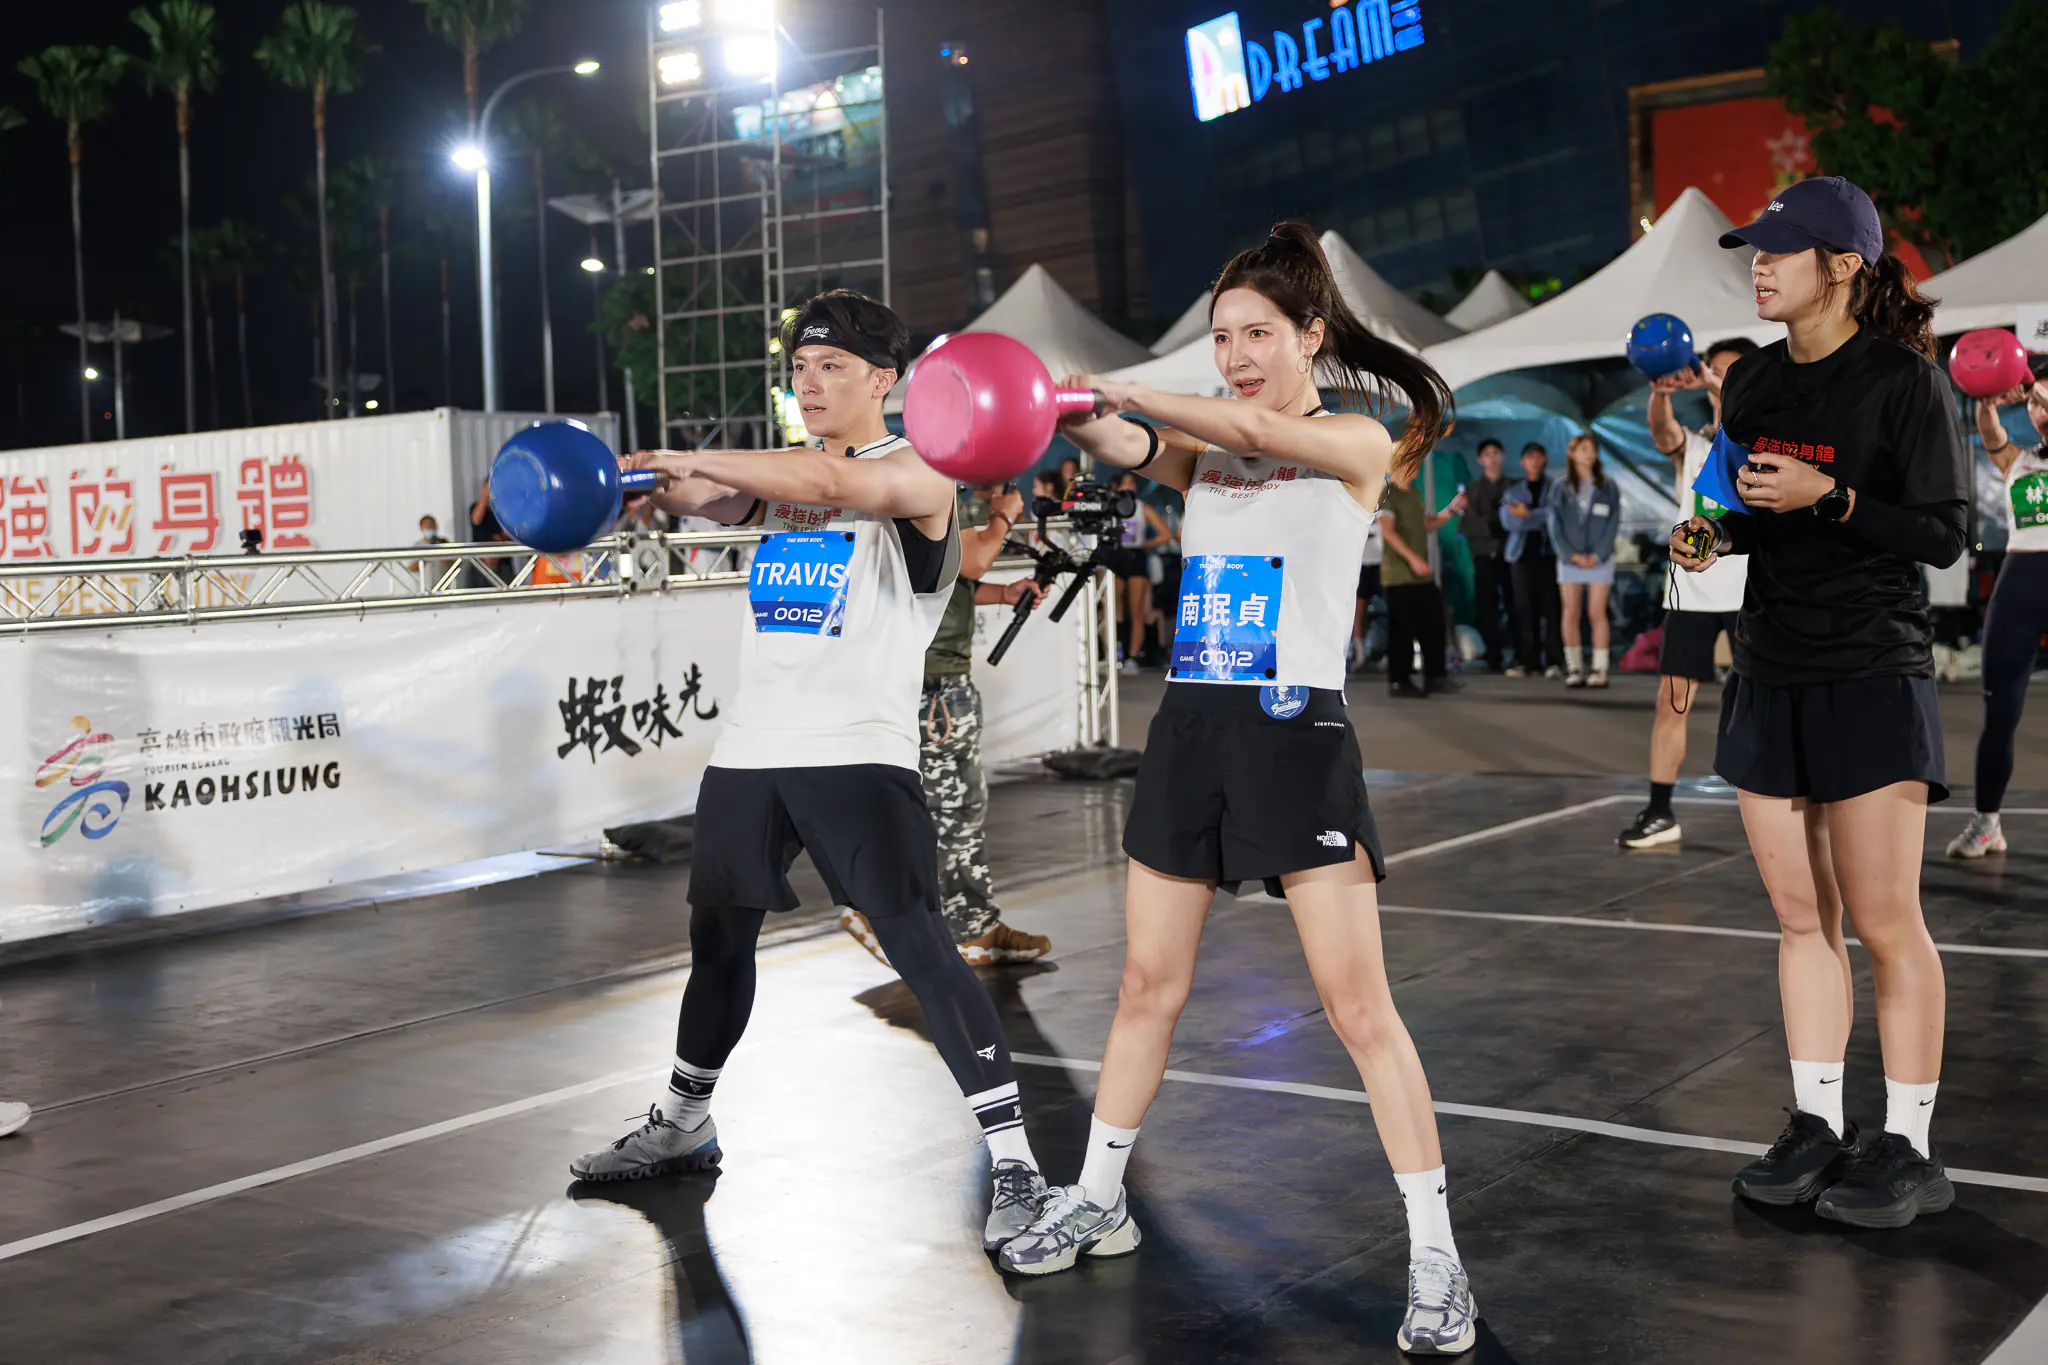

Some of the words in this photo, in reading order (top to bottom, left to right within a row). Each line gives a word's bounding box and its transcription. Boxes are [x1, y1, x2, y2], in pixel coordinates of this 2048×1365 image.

[1246, 0, 1396, 102] DREAM
[1767, 200, 1784, 212] Lee
[1208, 486, 1228, 497] THE
[755, 562, 846, 588] TRAVIS
[774, 607, 823, 623] 0012
[1181, 592, 1269, 628] 南珉貞
[1199, 649, 1254, 667] 0012
[144, 761, 341, 812] KAOHSIUNG
